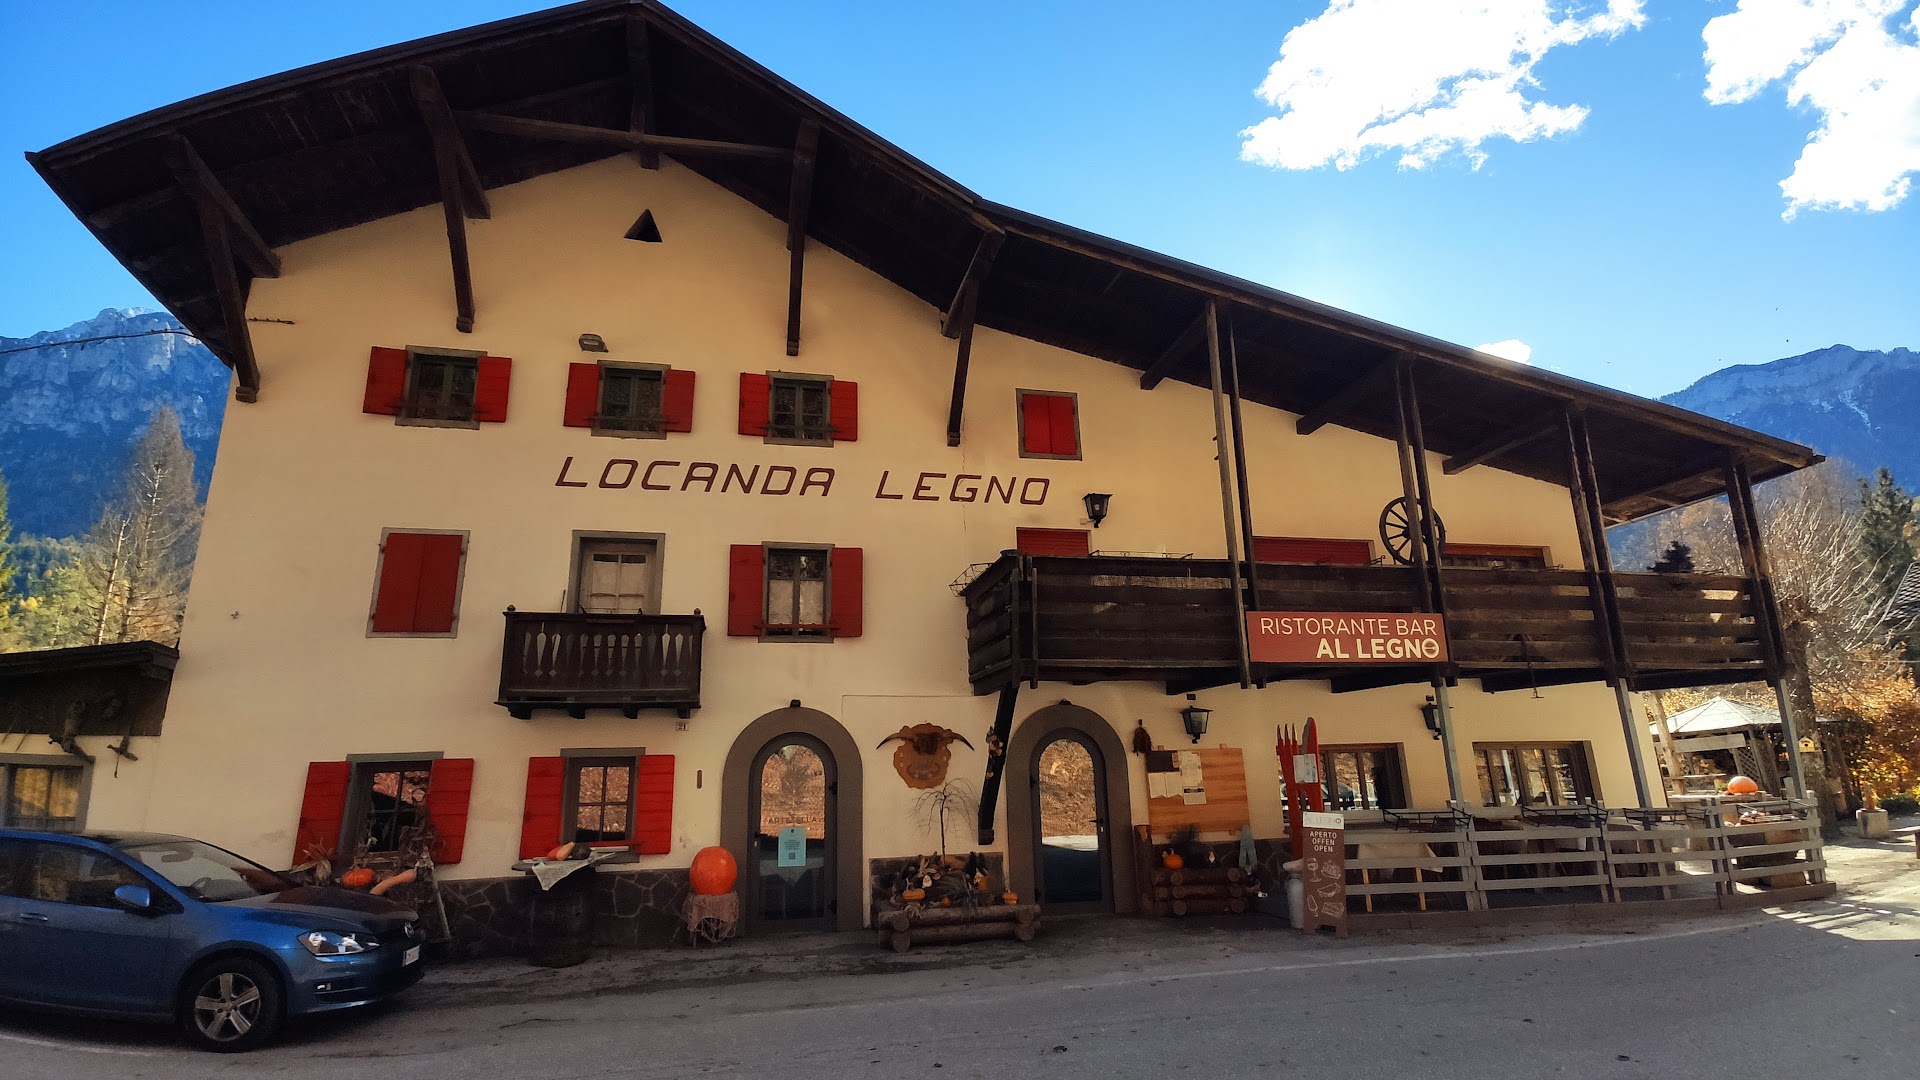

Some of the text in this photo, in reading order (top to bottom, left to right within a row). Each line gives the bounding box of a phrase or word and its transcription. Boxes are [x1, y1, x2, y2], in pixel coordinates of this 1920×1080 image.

[555, 456, 1050, 506] LOCANDA LEGNO
[1260, 617, 1437, 636] RISTORANTE BAR
[1316, 638, 1440, 659] AL LEGNO
